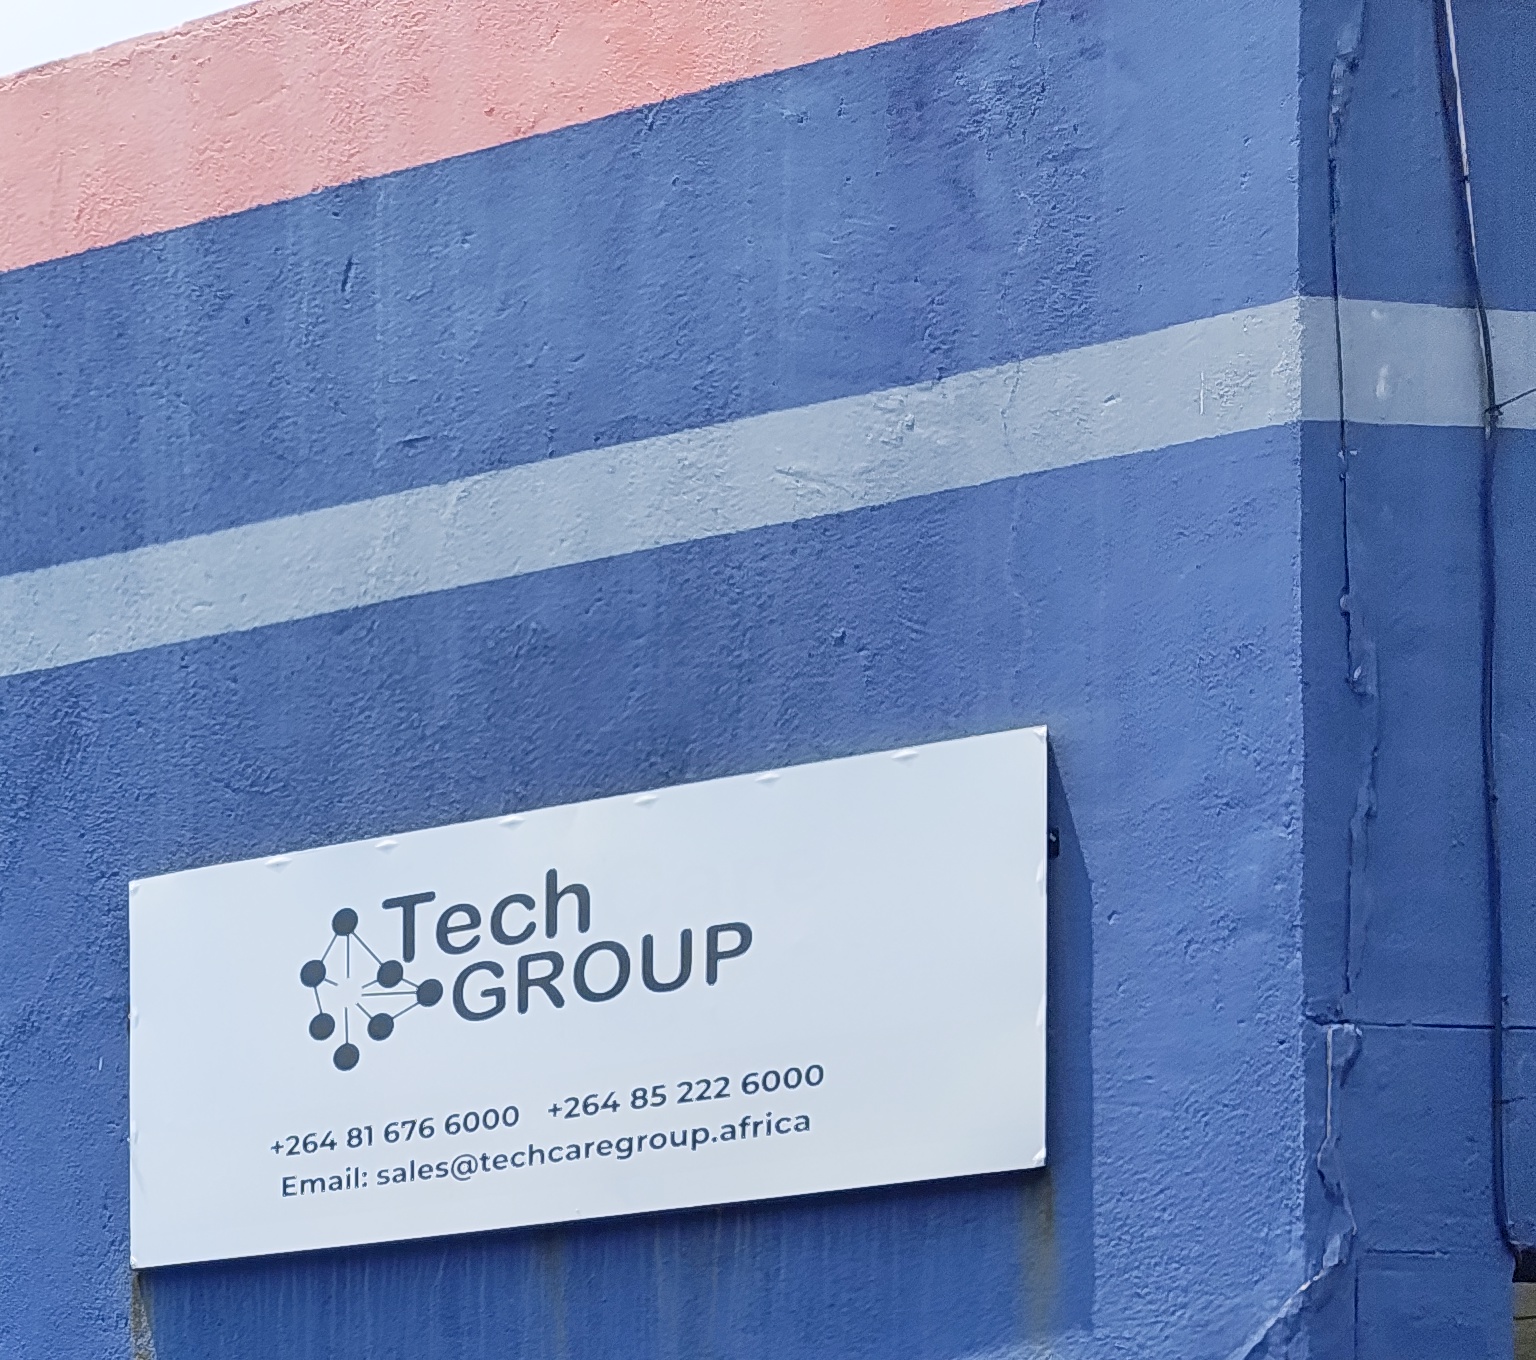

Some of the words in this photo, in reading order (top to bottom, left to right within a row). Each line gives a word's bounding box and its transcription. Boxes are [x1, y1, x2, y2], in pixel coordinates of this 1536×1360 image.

[382, 868, 592, 963] Tech
[452, 921, 753, 1022] GROUP
[271, 1131, 337, 1156] +264
[347, 1126, 372, 1148] 81
[384, 1118, 434, 1143] 676
[445, 1106, 519, 1135] 6000
[548, 1092, 620, 1119] +264
[631, 1085, 666, 1109] 85
[677, 1077, 730, 1103] 222
[742, 1065, 823, 1094] 6000
[283, 1167, 367, 1197] Email:
[376, 1111, 810, 1187] sales@techcaregroup.africa
